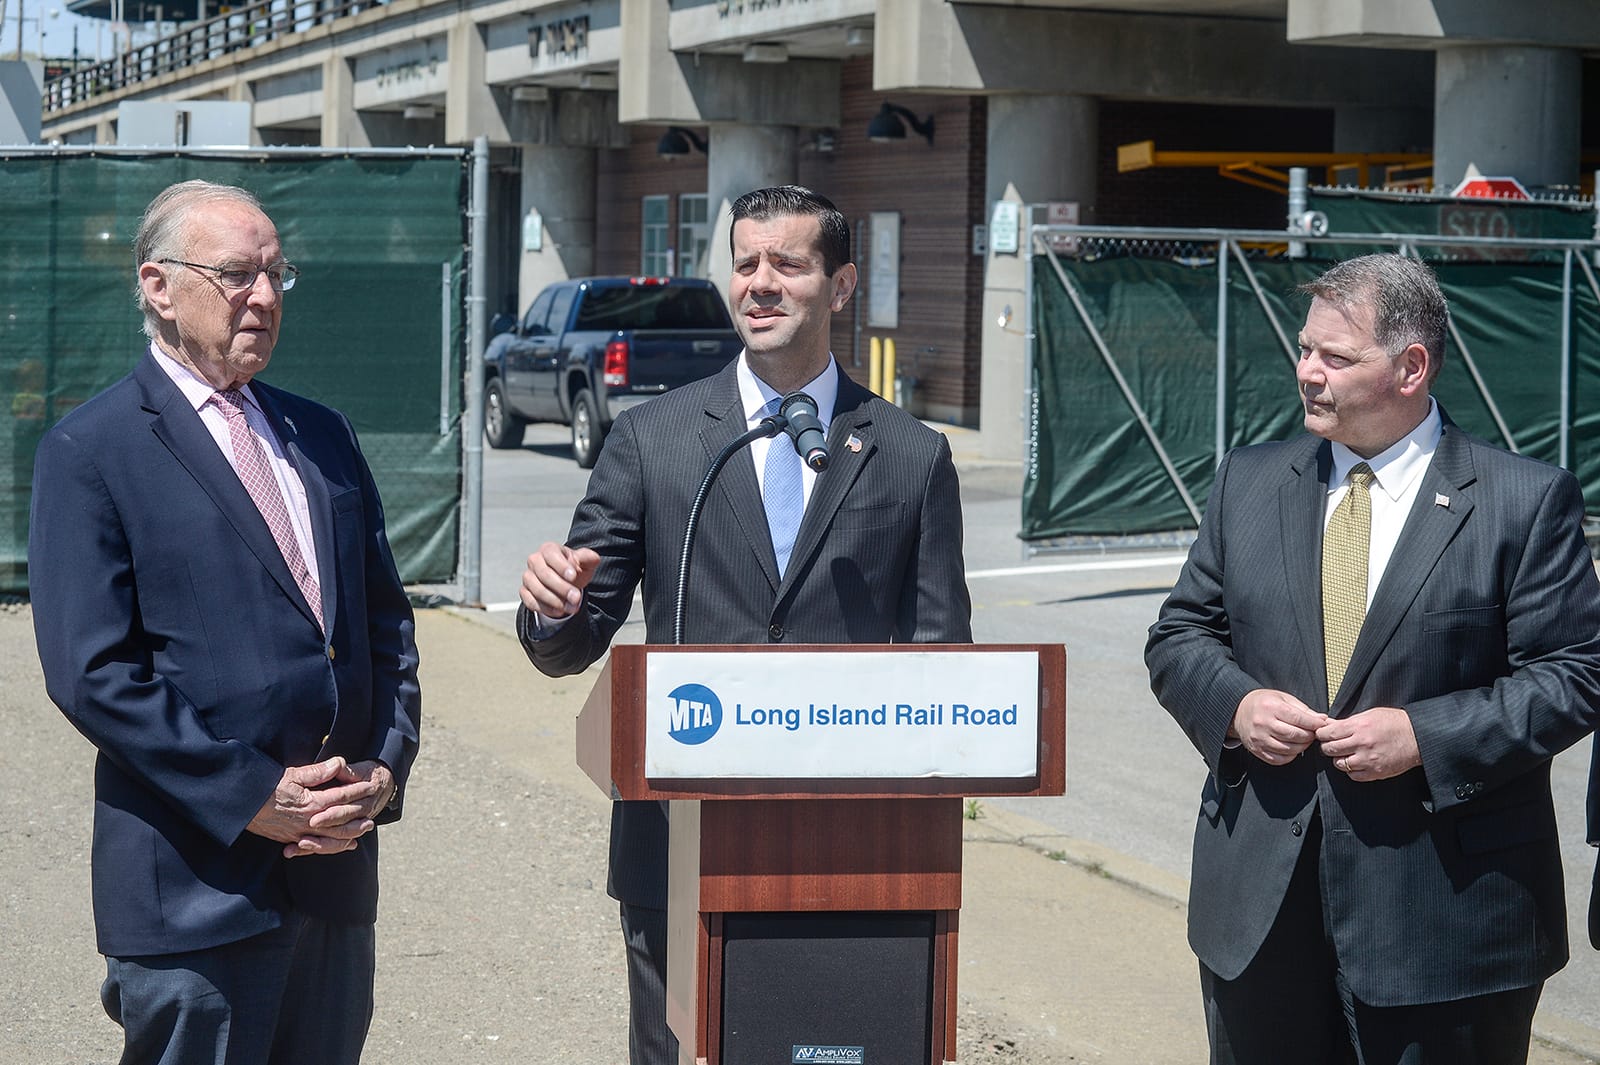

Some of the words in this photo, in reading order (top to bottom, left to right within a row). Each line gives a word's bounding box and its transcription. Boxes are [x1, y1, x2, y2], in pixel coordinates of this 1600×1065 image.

[1447, 210, 1534, 238] STO
[667, 696, 713, 733] MTA
[736, 704, 800, 731] Long
[809, 704, 886, 725] Island
[895, 704, 943, 725] Rail
[952, 704, 1017, 725] Road
